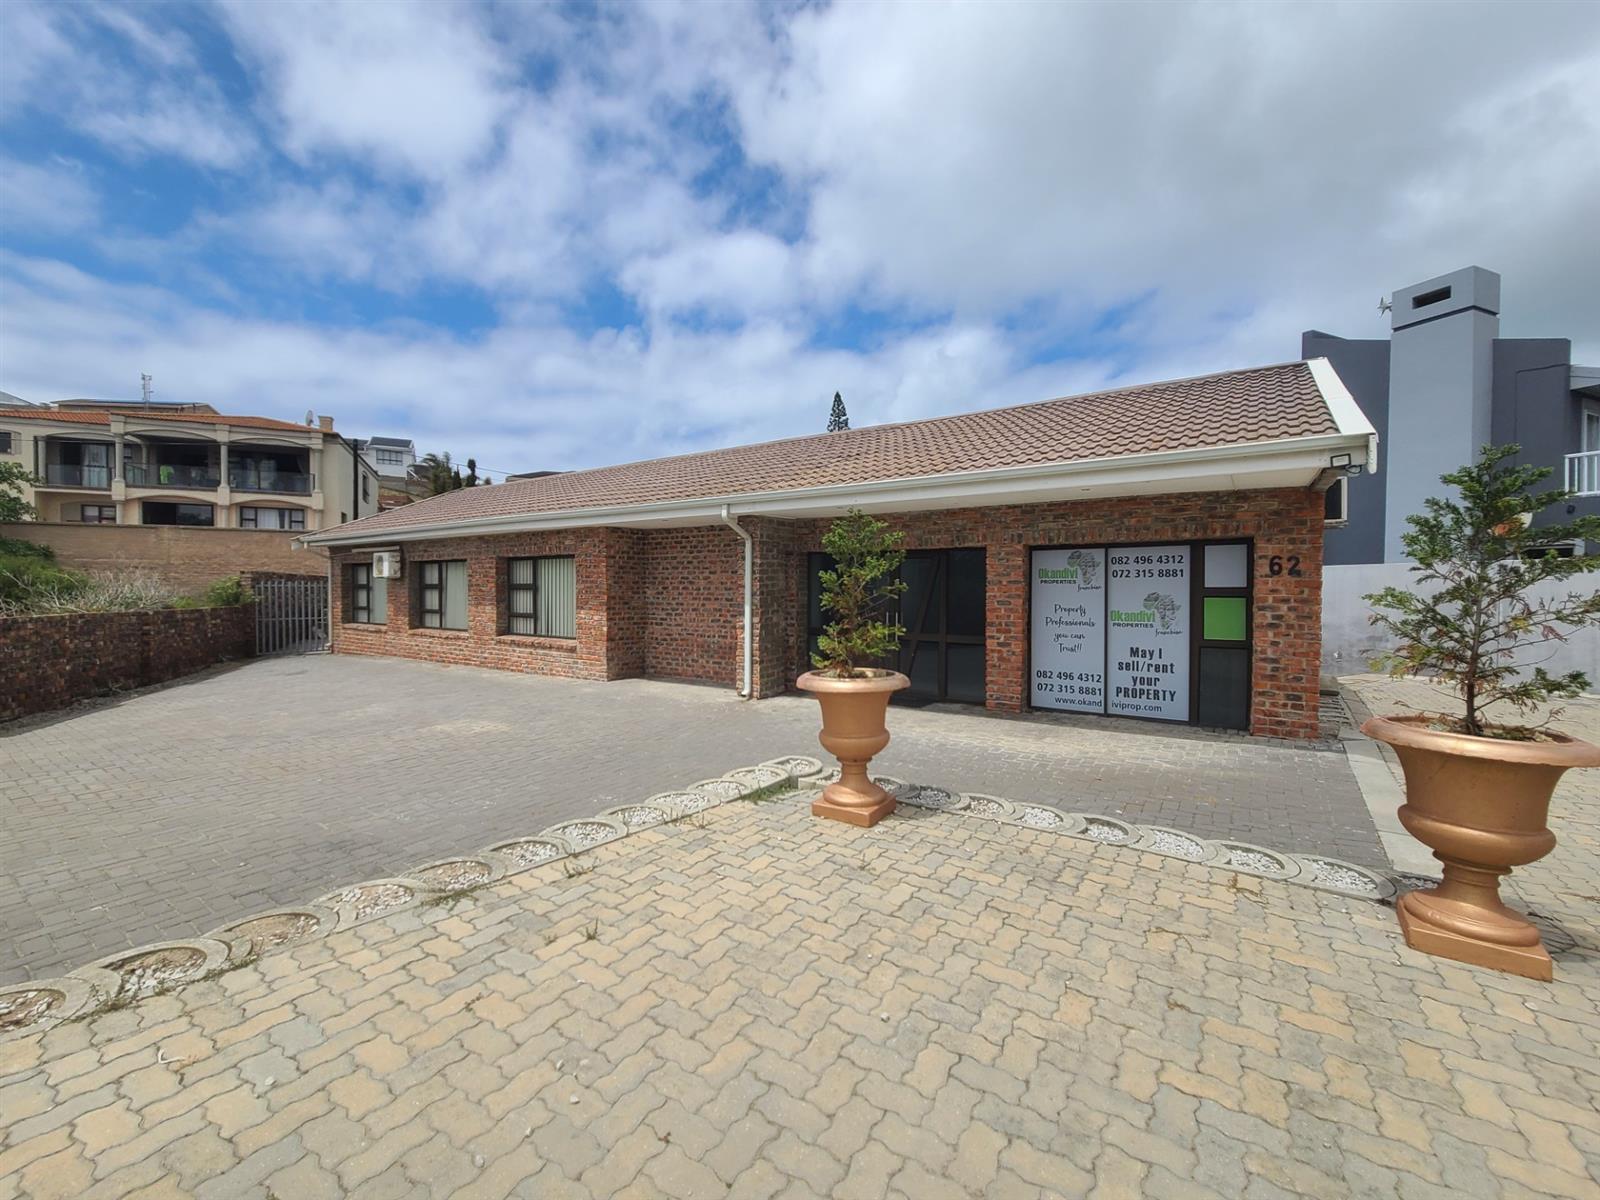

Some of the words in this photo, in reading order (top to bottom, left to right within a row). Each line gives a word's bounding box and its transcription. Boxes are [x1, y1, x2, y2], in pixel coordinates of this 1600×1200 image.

[1111, 556, 1130, 565] 082
[1133, 555, 1153, 564] 496
[1156, 554, 1184, 564] 4312
[1269, 555, 1302, 577] 62
[1112, 569, 1131, 578] 072
[1134, 569, 1154, 578] 315
[1157, 568, 1184, 578] 8881
[1054, 603, 1086, 616] Property
[1045, 616, 1096, 628] Professionals
[1053, 632, 1069, 642] you
[1130, 646, 1155, 660] May
[1158, 647, 1162, 659] I
[1117, 660, 1175, 674] sell/rent
[1036, 670, 1054, 679] 082
[1056, 671, 1075, 681] 496
[1077, 672, 1102, 683] 4312
[1131, 675, 1160, 687] your
[1037, 682, 1054, 692] 072
[1057, 684, 1075, 694] 315
[1078, 686, 1102, 696] 8881
[1115, 686, 1176, 702] PROPERTY
